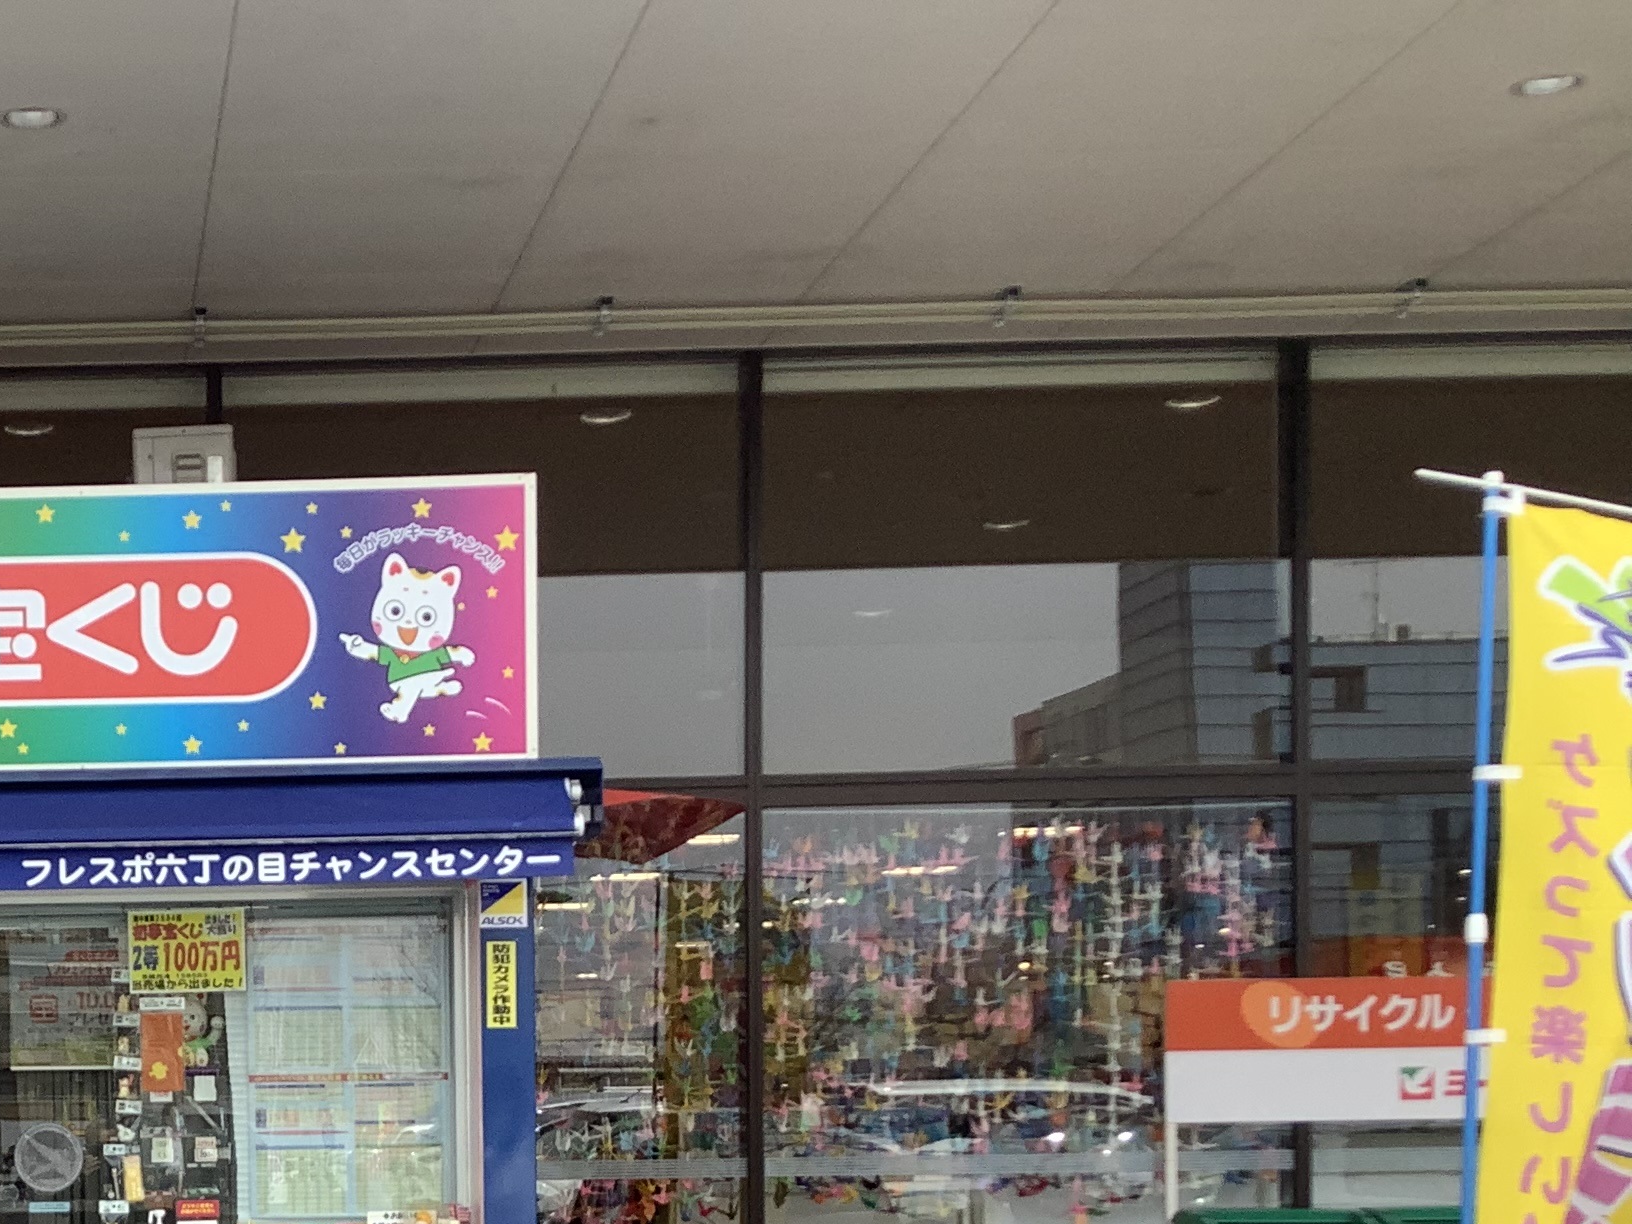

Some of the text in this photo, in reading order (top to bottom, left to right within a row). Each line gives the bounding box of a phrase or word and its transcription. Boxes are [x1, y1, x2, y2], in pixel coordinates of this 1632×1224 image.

[21, 846, 561, 886] フレスポ六丁の目チャンスセンター
[481, 915, 523, 925] ALSOK
[163, 940, 240, 972] 100万円
[492, 944, 511, 1025] 防犯カメラ作動中
[1270, 994, 1455, 1032] リサイクル
